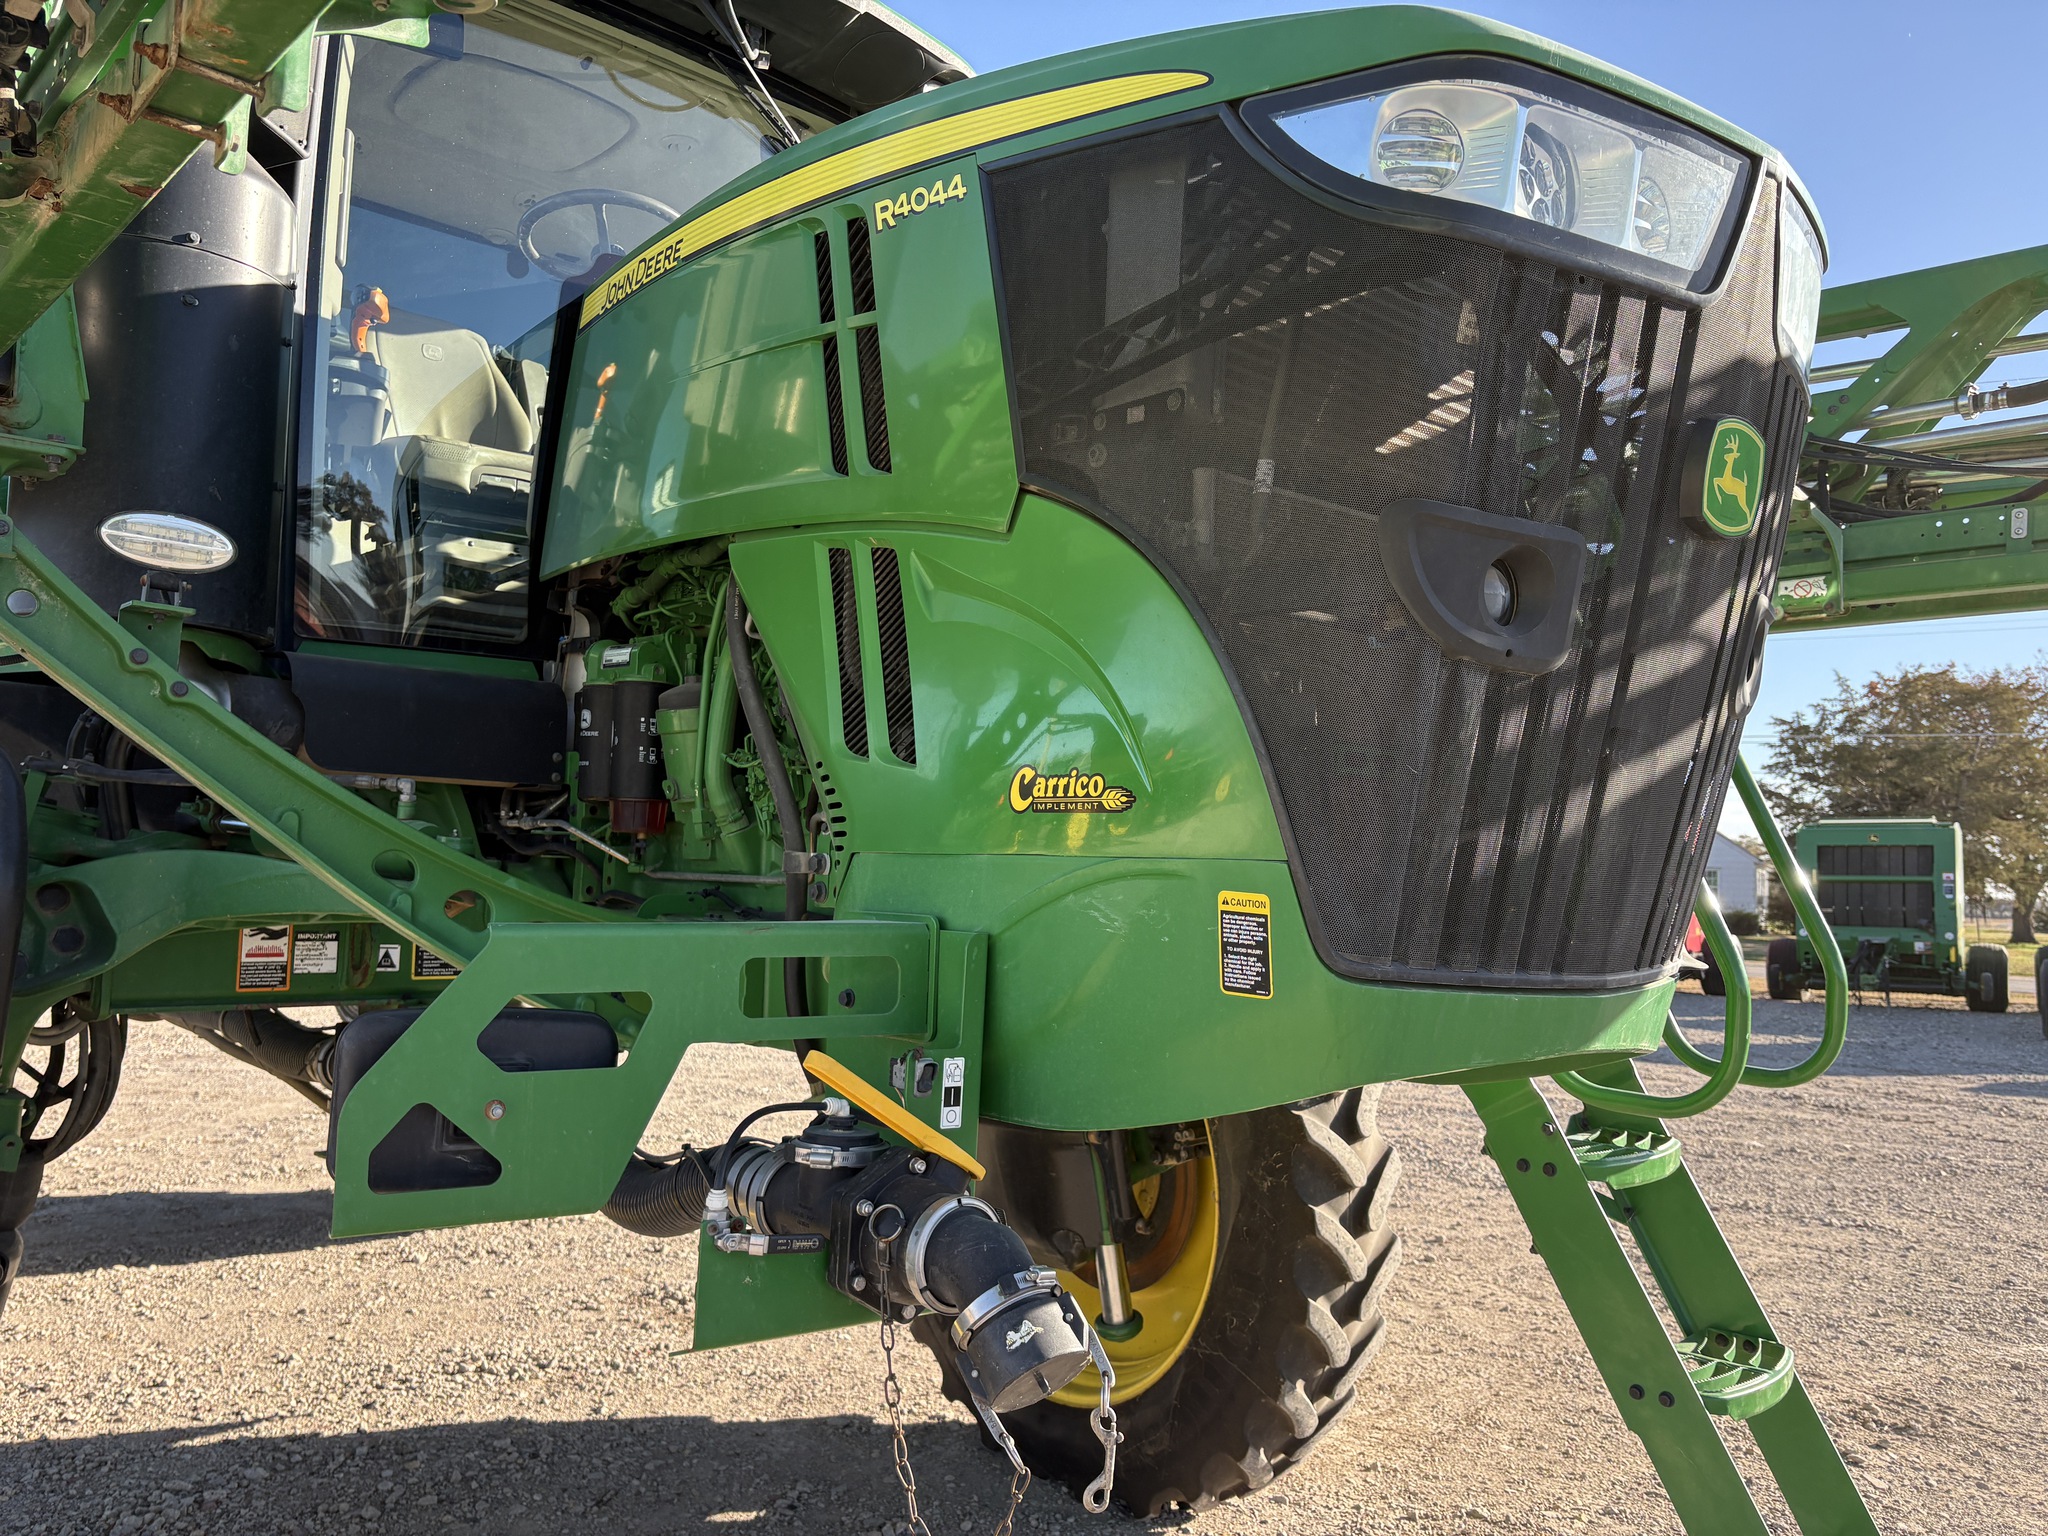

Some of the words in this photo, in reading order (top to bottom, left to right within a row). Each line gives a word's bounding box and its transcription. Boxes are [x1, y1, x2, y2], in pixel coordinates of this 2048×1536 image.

[874, 174, 967, 234] R4044
[600, 269, 635, 312] JOHN
[635, 239, 683, 285] DEERE
[1010, 767, 1104, 811] Carrico
[1033, 802, 1098, 810] IMPLEMENT
[1230, 898, 1266, 908] CAUTION
